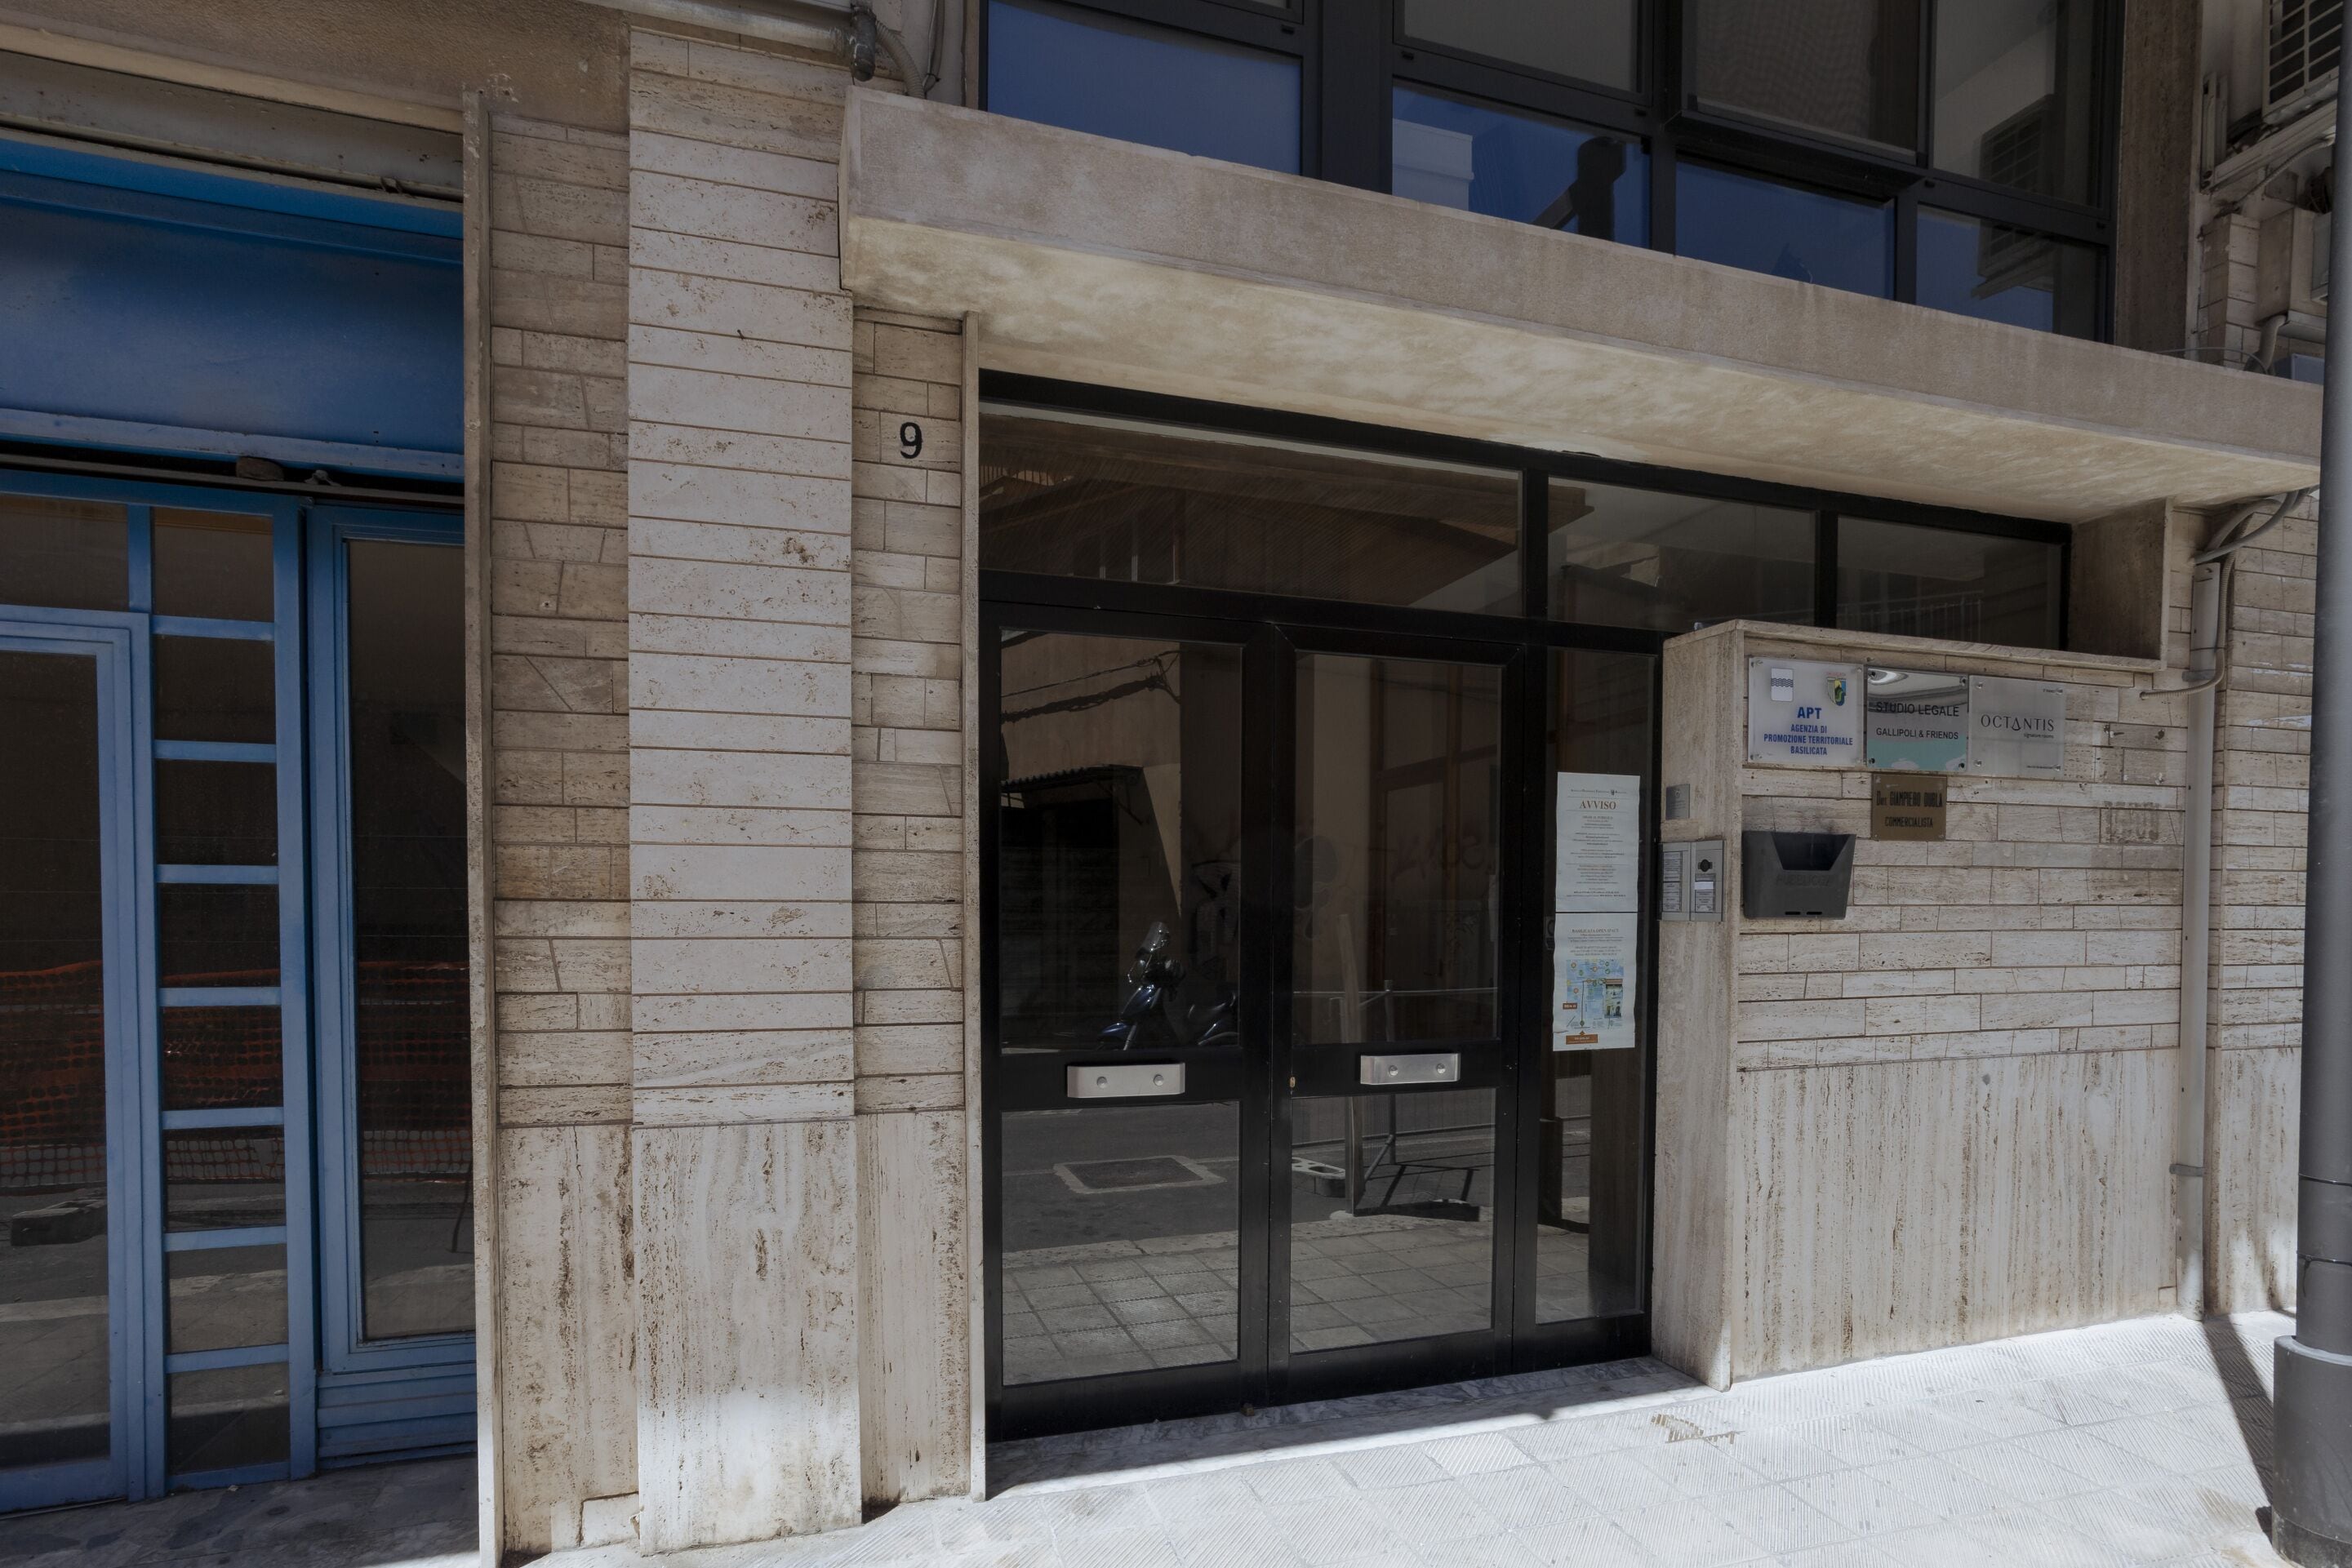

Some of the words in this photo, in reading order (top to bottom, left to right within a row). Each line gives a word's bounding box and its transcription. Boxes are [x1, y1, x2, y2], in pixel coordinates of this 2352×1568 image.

[900, 422, 923, 459] 9
[1797, 706, 1822, 720] APT
[1876, 701, 1915, 714] STUDIO
[1918, 704, 1959, 717] LEGALE
[1981, 714, 2054, 731] OCTANTIS
[1790, 724, 1819, 734] AGENZIA
[1821, 726, 1827, 734] DI
[1876, 727, 1917, 737] GALLIPOLI
[1919, 730, 1924, 738] &
[1926, 730, 1959, 740] FRIENDS
[1763, 734, 1806, 744] PROMOZIONE
[1808, 735, 1853, 746] TERRITORIALE
[1790, 746, 1827, 755] BASILICATA
[1580, 800, 1616, 810] AVVISO
[1885, 816, 1933, 828] COMMERCIALISTA
